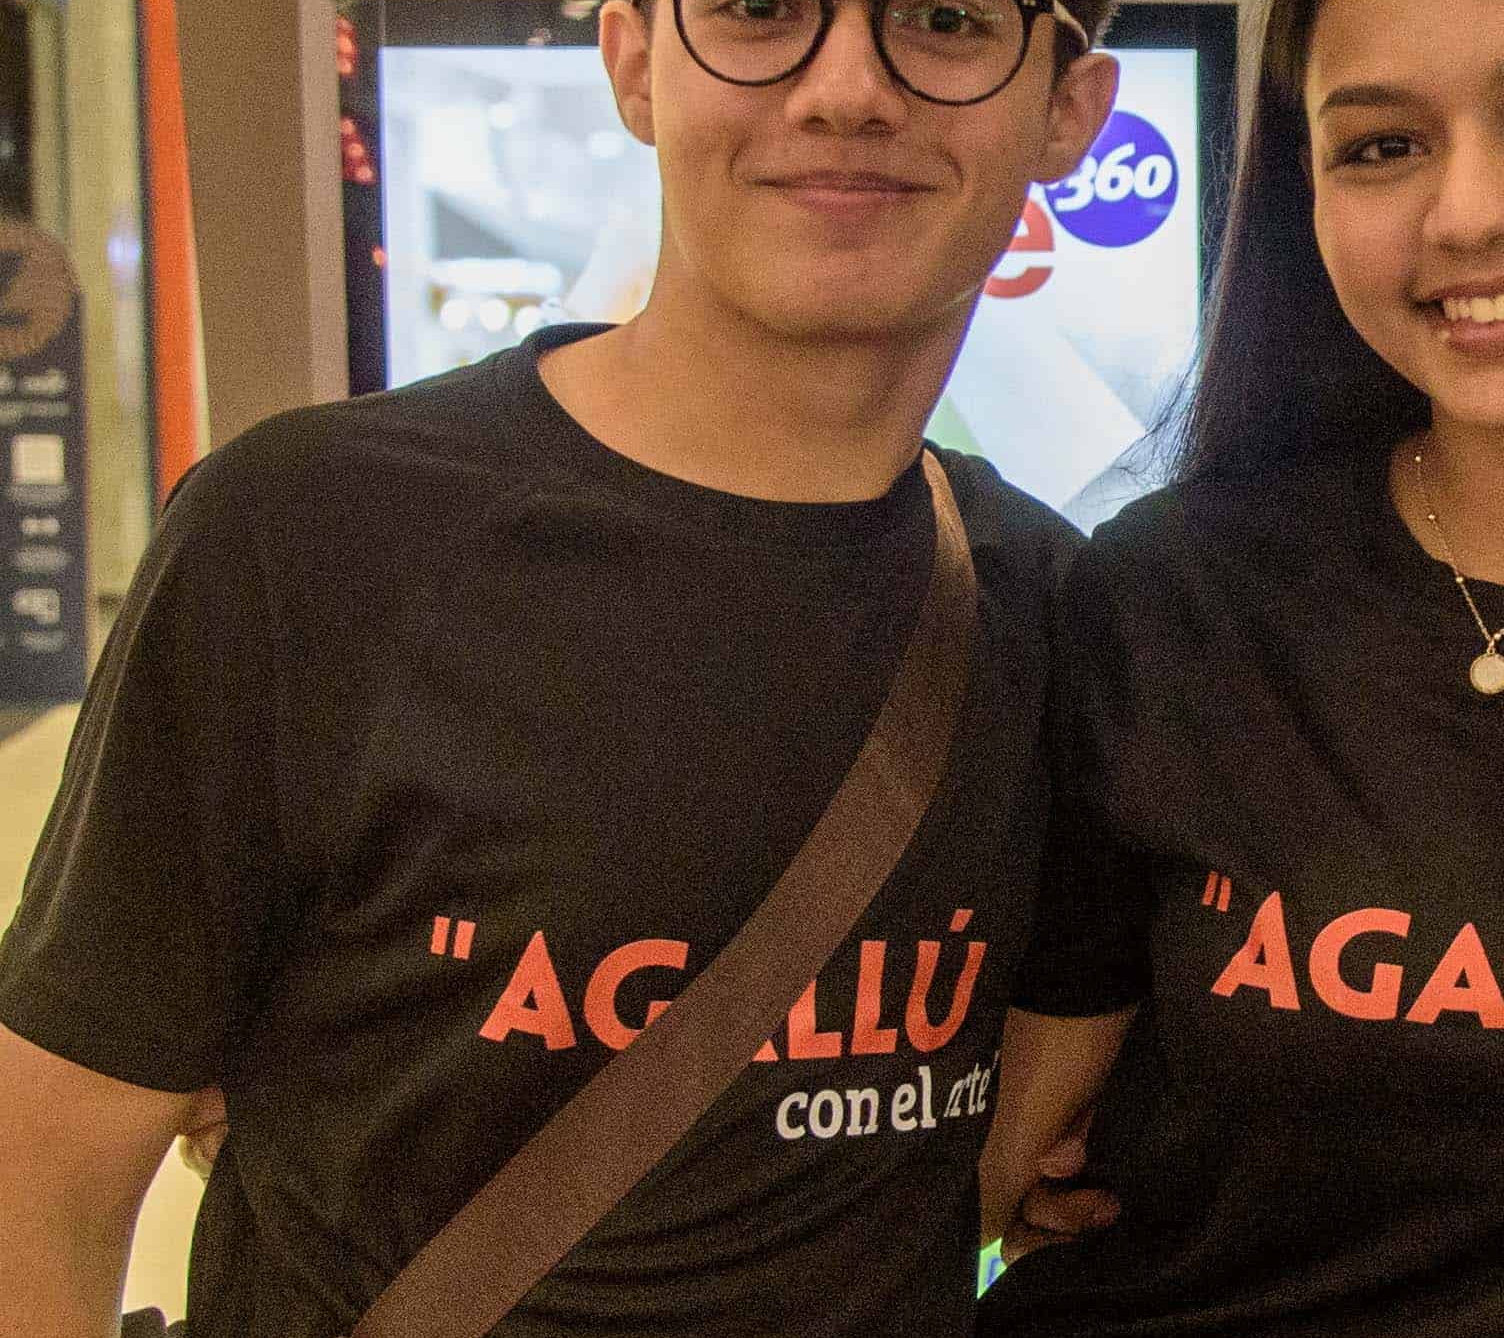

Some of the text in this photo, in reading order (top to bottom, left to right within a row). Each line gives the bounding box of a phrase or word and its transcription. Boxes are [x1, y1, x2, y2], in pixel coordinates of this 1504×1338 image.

[1054, 142, 1173, 212] 360
[430, 909, 987, 1063] "AGLLÚ
[775, 1087, 879, 1140] con
[890, 1065, 937, 1132] el
